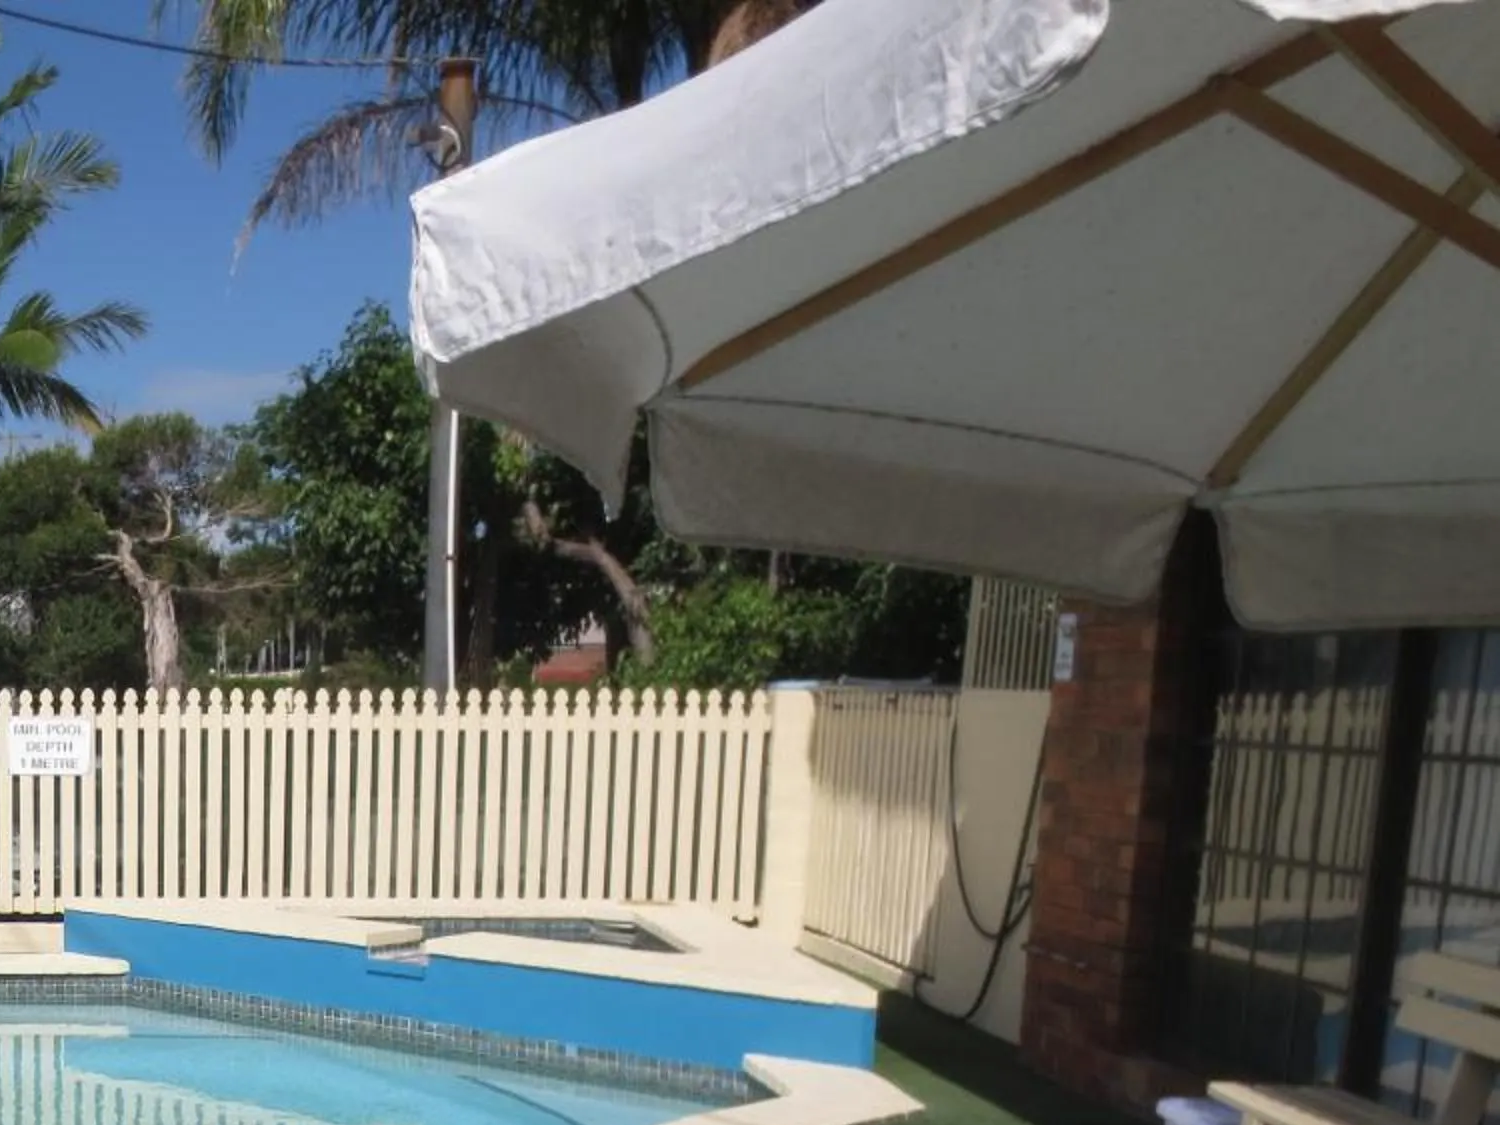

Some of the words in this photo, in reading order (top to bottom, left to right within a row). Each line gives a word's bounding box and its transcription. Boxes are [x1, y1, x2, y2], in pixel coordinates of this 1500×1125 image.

[46, 723, 84, 736] POOL
[25, 741, 73, 752] DEPTH
[20, 757, 26, 768] 1
[31, 757, 79, 768] METRE
